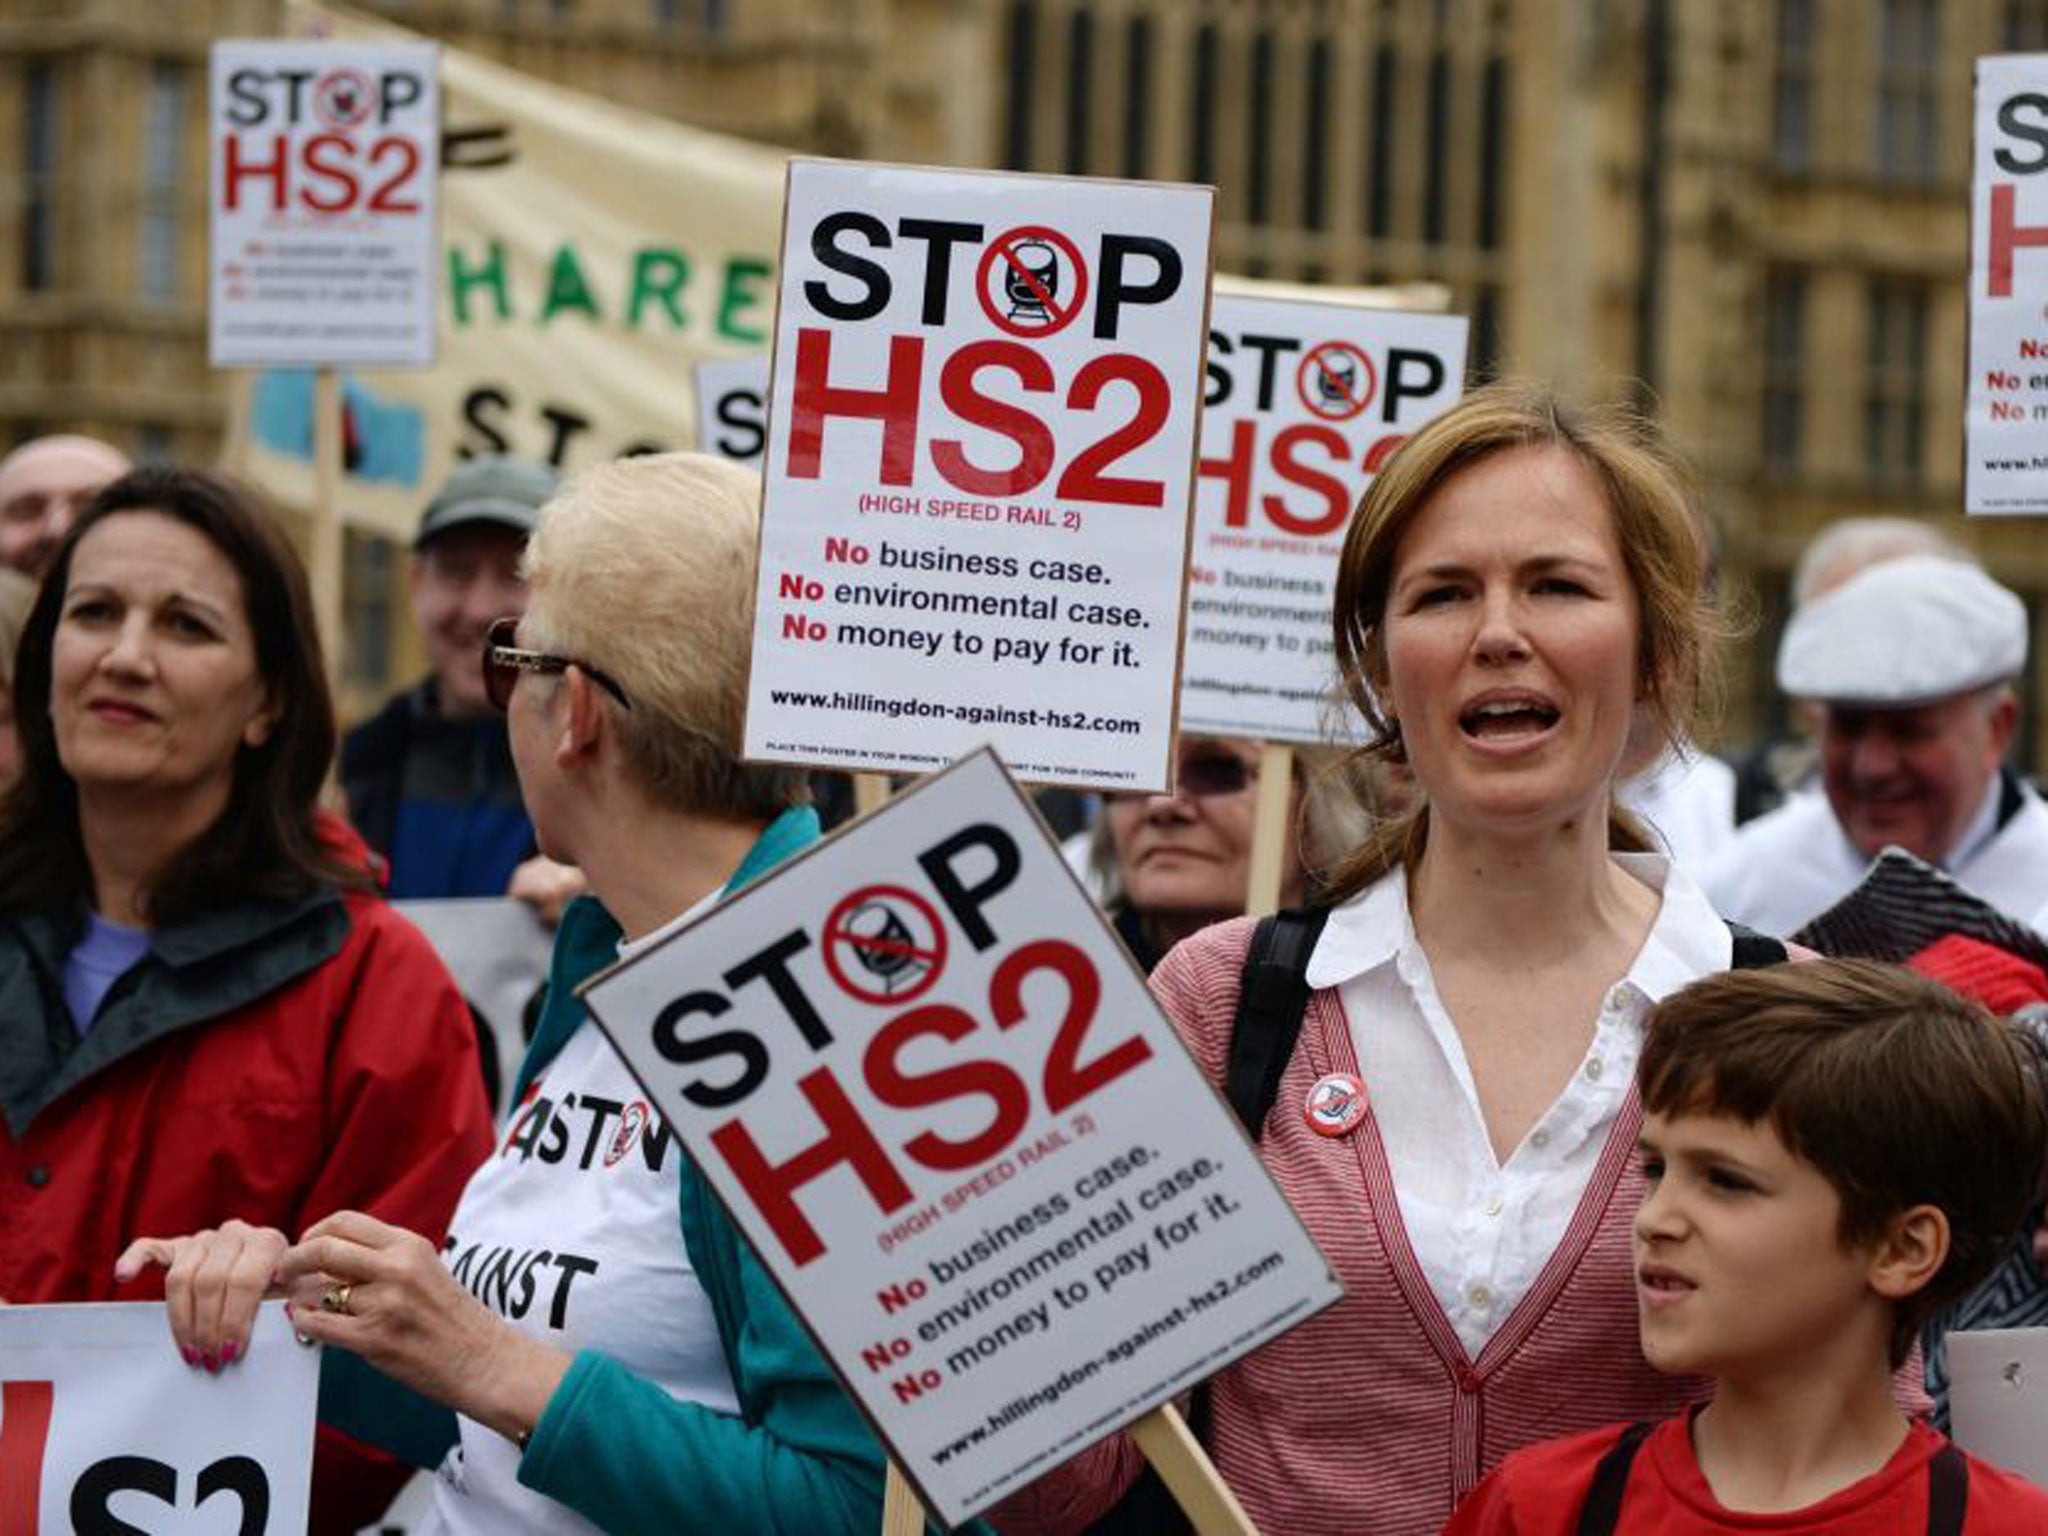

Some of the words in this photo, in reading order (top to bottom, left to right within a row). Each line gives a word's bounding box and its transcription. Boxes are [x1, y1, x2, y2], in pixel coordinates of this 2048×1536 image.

[227, 68, 422, 127] STOP
[224, 133, 420, 213] HS2
[448, 240, 772, 343] HARE
[803, 211, 1183, 341] STOP
[786, 327, 1171, 507] HS2
[1986, 370, 2021, 390] No
[1989, 402, 2025, 421] No
[456, 388, 668, 467] ST
[858, 493, 921, 515] (HIGH
[927, 501, 1000, 523] SPEED
[1006, 507, 1056, 527] RAIL
[1062, 511, 1082, 533] 2)
[825, 536, 870, 564] No
[879, 541, 1019, 577] business
[1029, 558, 1112, 585] case.
[1224, 568, 1325, 594] business
[778, 573, 824, 602] No
[834, 581, 1057, 621] environmental
[1068, 601, 1150, 629] case.
[781, 613, 827, 643] No
[837, 621, 944, 656] money
[953, 629, 983, 655] to
[993, 635, 1050, 666] pay
[1059, 636, 1103, 665] for
[1112, 640, 1141, 668] it.
[1192, 626, 1268, 651] money
[1277, 632, 1300, 651] to
[770, 688, 1141, 735] www.hillingdon-against-hs2.com
[652, 823, 1021, 1109] STOP
[710, 938, 1154, 1268] HS2
[877, 1205, 941, 1256] (HIGH
[943, 1165, 1016, 1216] SPEED
[1019, 1137, 1071, 1170] RAIL
[1074, 1113, 1097, 1141] 2)
[861, 1331, 912, 1374] No
[917, 1201, 1133, 1343] environmental
[1138, 1156, 1224, 1212] case.
[876, 1274, 928, 1315] No
[929, 1195, 1070, 1284] business
[1074, 1144, 1160, 1200] case.
[444, 1235, 599, 1330] AINST
[890, 1366, 942, 1405] No
[946, 1299, 1051, 1376] money
[1054, 1277, 1089, 1311] to
[1099, 1243, 1152, 1293] pay
[1154, 1206, 1202, 1251] for
[1207, 1190, 1242, 1223] it.
[930, 1249, 1285, 1466] www.hillingdon-against-hs2.com
